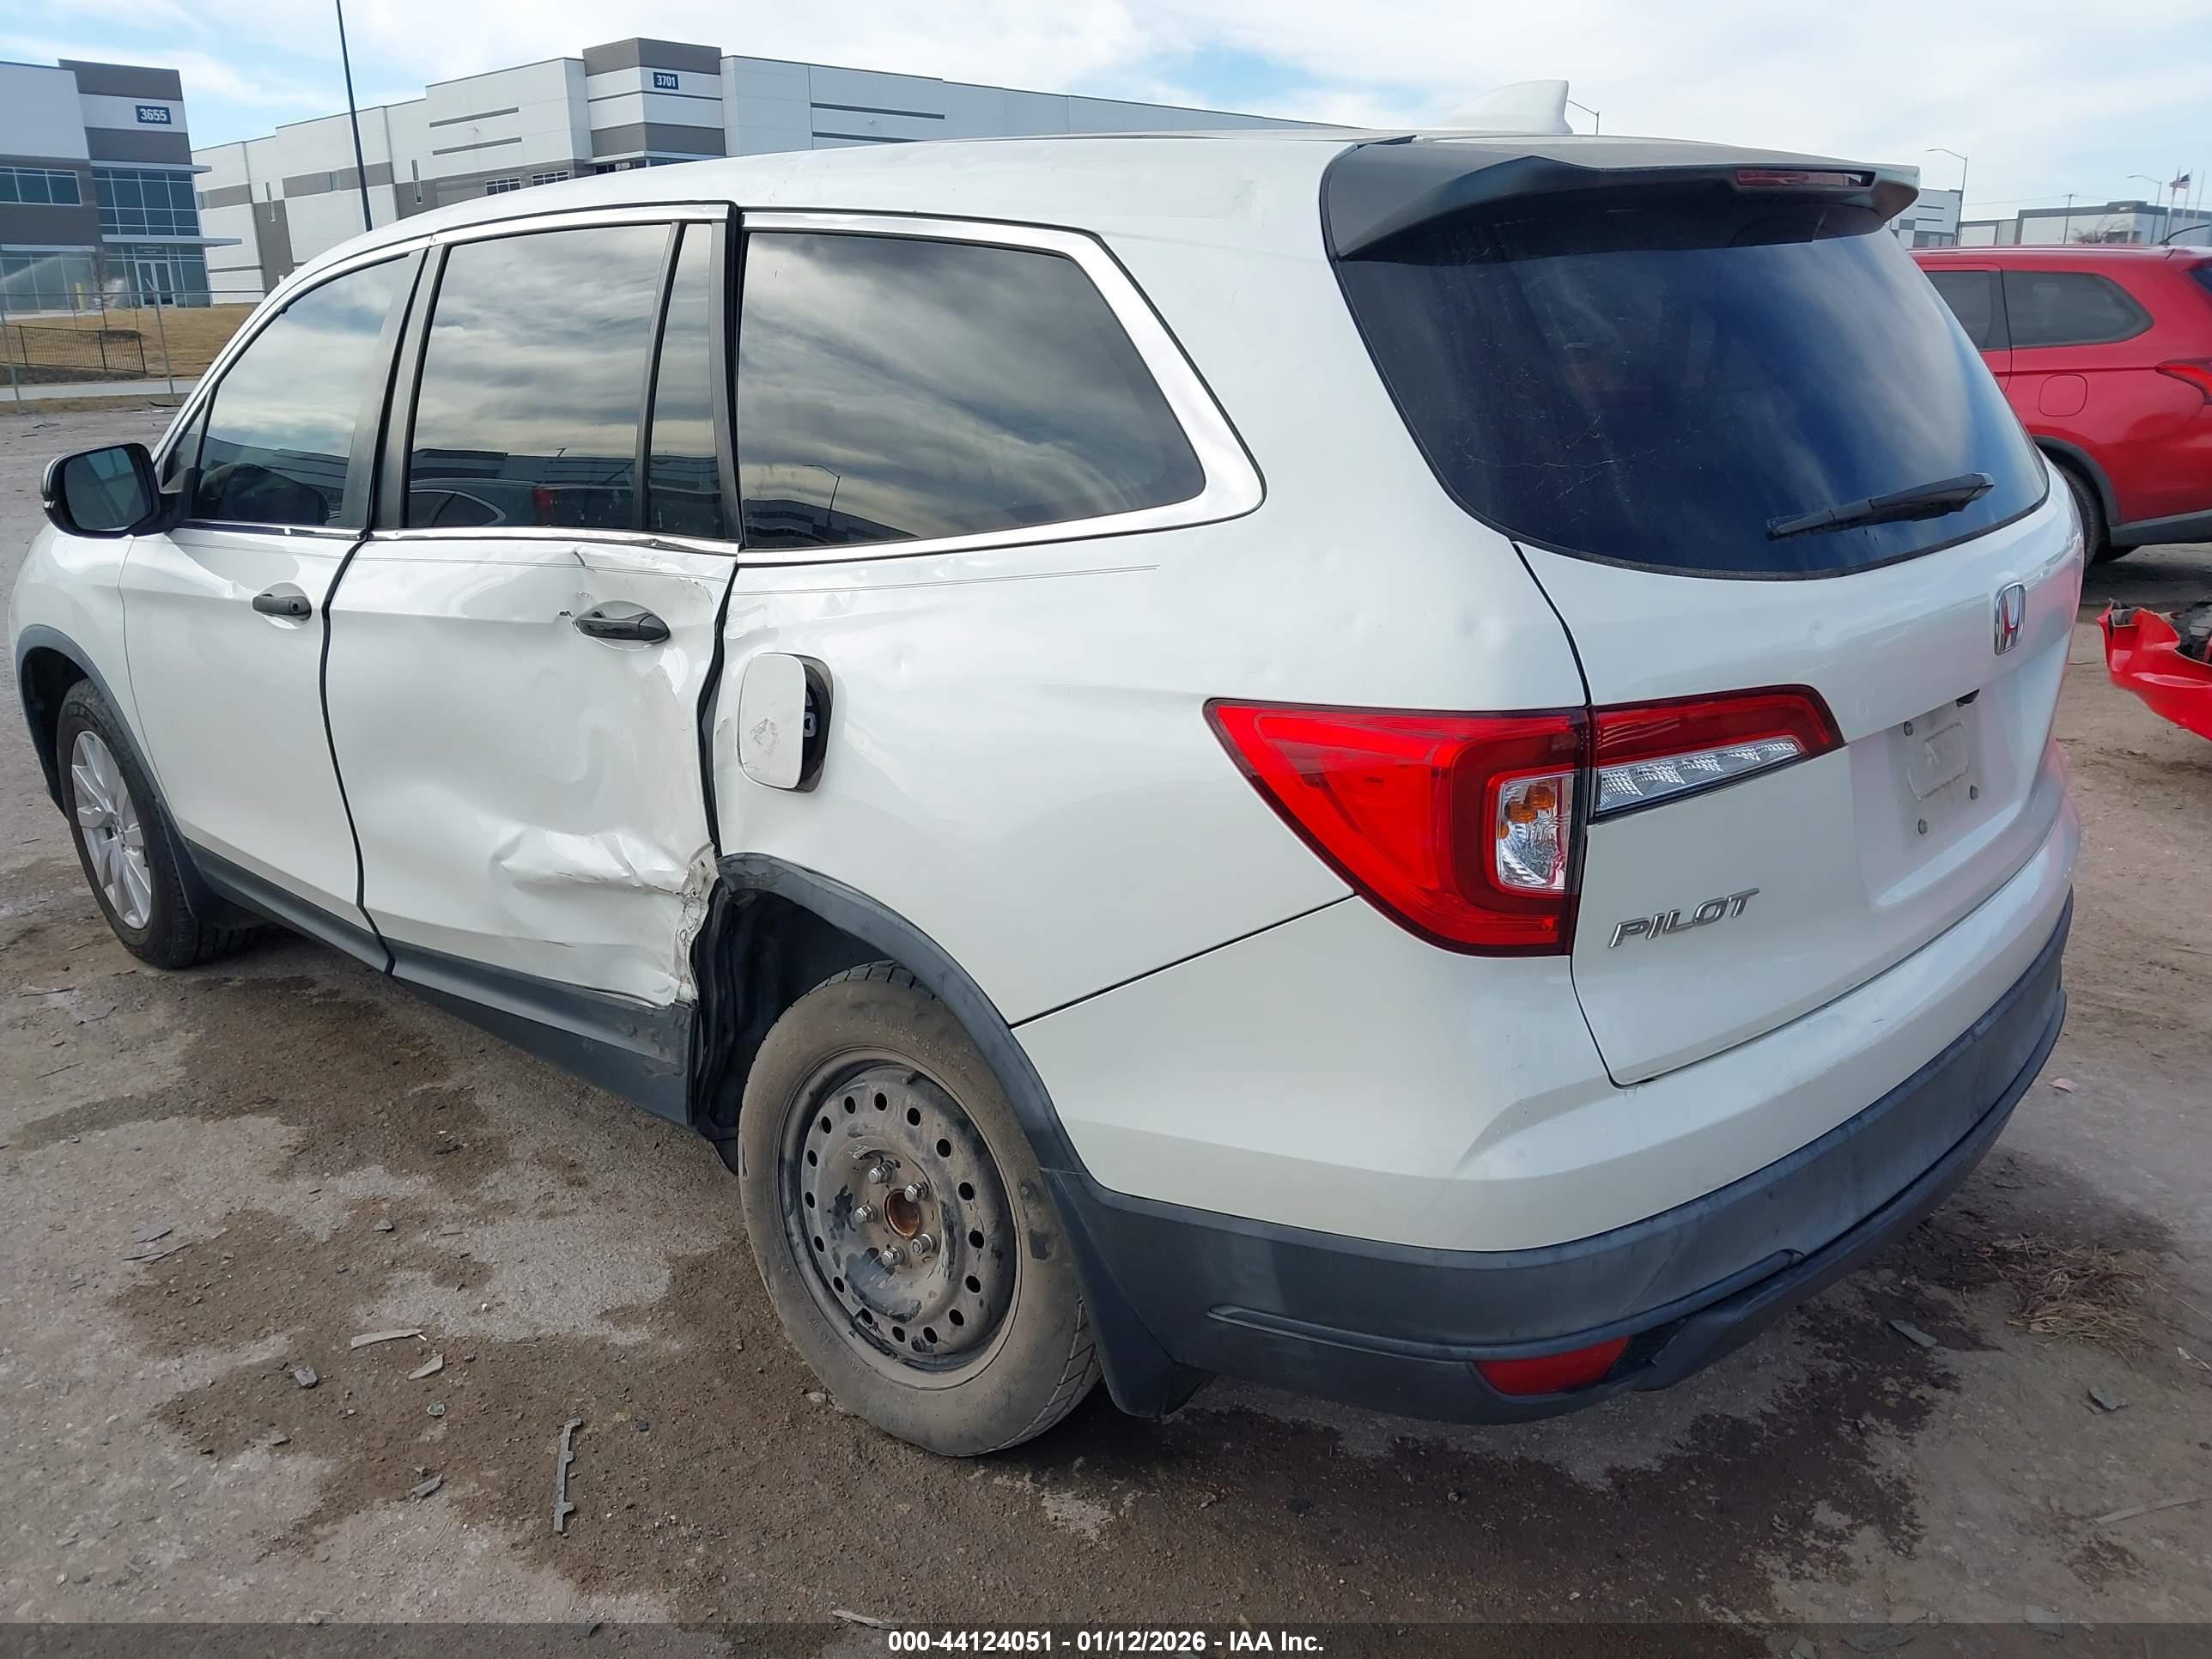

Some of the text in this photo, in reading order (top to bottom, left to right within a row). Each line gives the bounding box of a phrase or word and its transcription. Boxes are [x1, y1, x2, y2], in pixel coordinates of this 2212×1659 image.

[656, 75, 676, 88] 3701
[139, 108, 167, 121] 3655
[1608, 888, 1759, 948] PILOT
